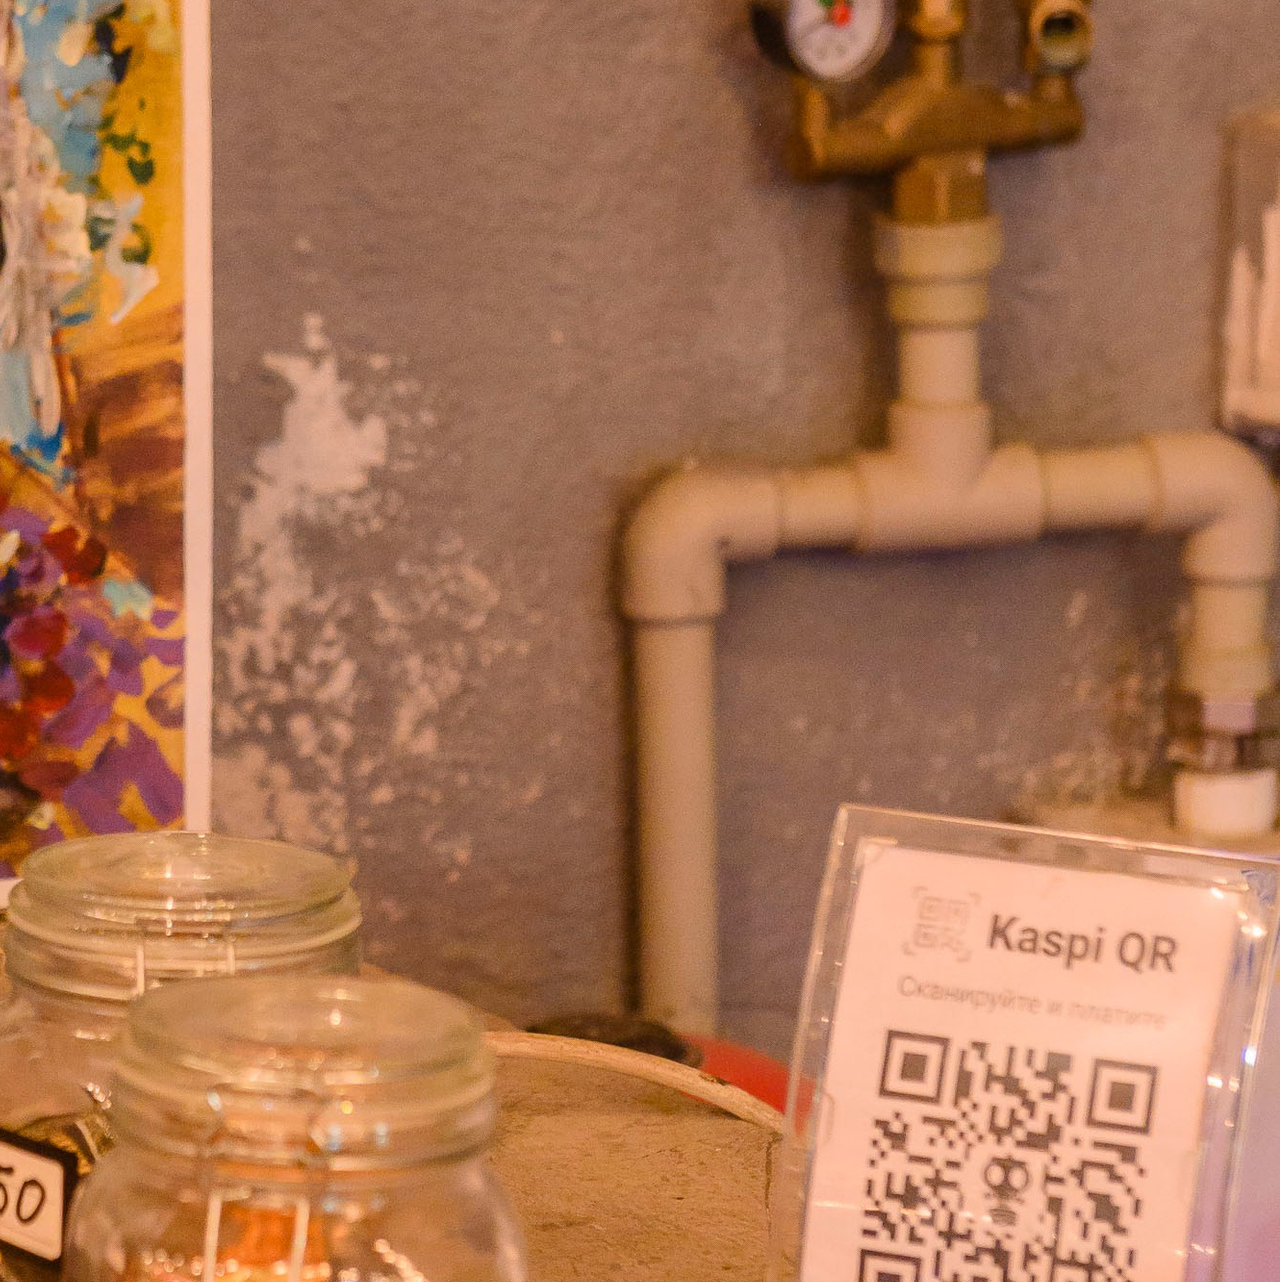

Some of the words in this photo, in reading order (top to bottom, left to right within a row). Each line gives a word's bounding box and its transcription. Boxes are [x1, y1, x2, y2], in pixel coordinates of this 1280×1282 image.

[988, 914, 1107, 970] Kaspi
[1117, 931, 1178, 973] QR
[898, 975, 1041, 1014] Сканируйте
